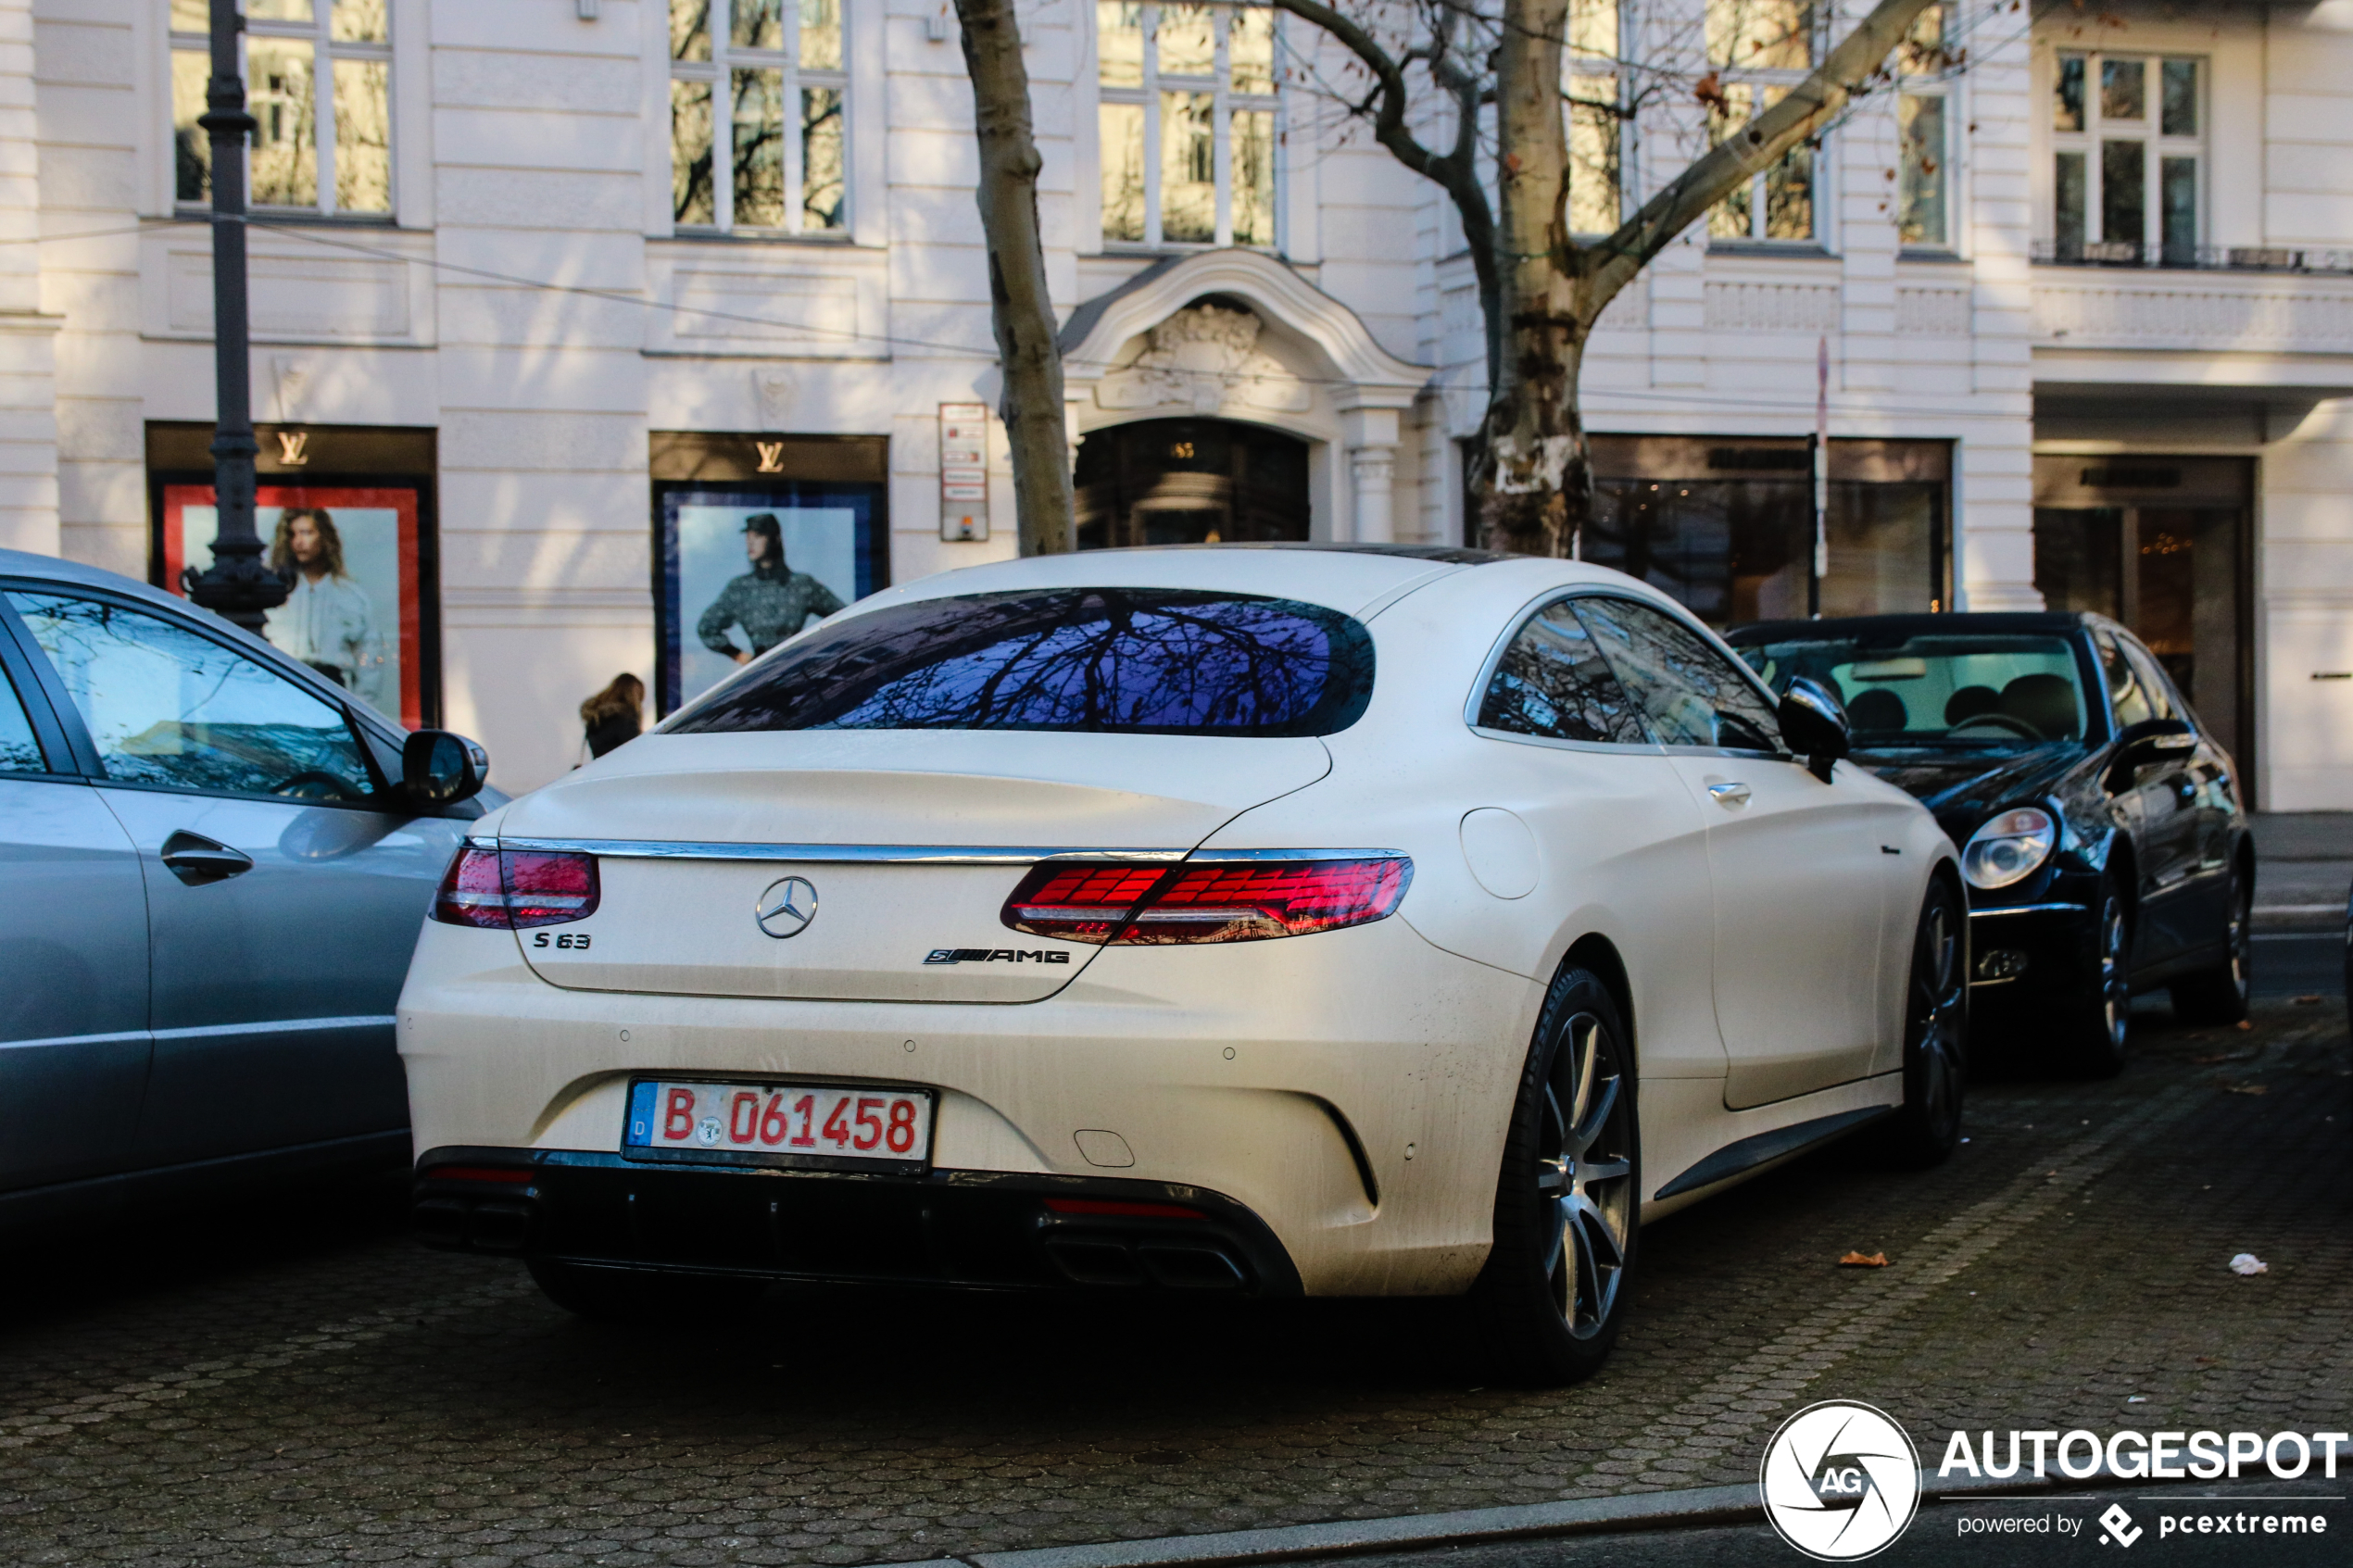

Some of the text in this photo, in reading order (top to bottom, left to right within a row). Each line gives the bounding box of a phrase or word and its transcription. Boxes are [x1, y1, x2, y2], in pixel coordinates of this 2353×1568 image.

[534, 933, 591, 949] S 63
[987, 949, 1070, 963] AMG
[663, 1087, 916, 1153] B 061458
[635, 1121, 645, 1135] D
